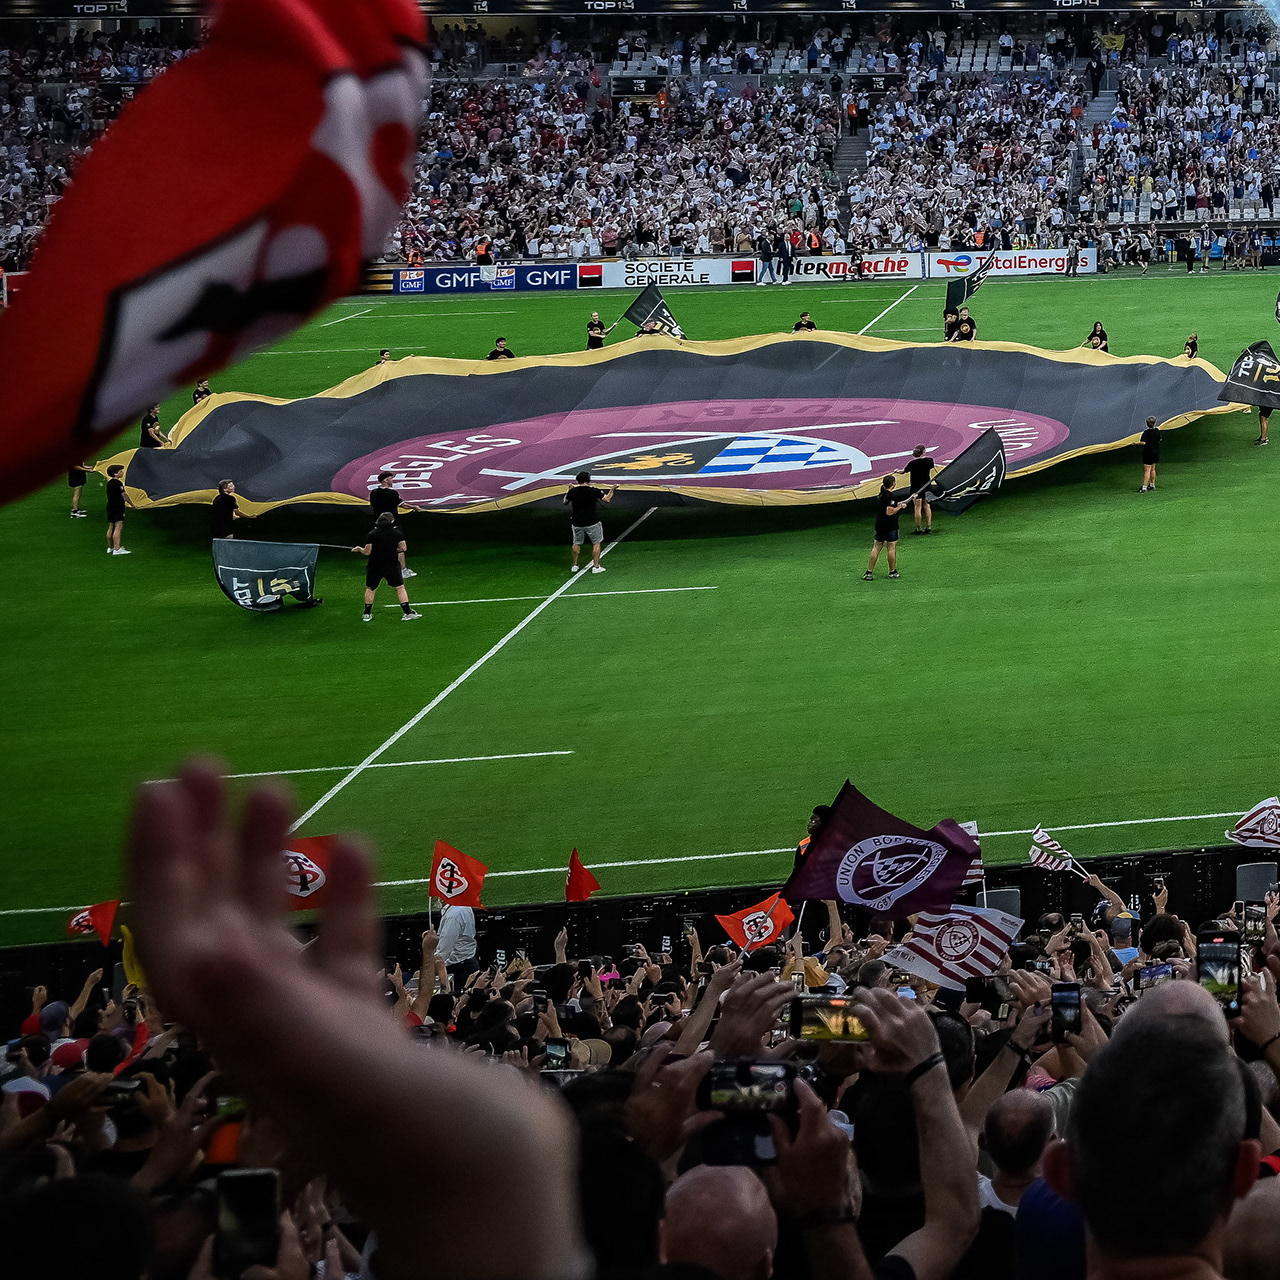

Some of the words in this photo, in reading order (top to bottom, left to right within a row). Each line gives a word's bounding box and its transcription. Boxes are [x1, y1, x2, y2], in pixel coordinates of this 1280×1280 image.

[624, 262, 695, 274] SOCIETE
[975, 255, 1089, 272] TtalEnergs
[402, 280, 423, 289] GMF
[435, 273, 481, 288] GMF
[492, 278, 514, 287] GMF
[526, 270, 572, 285] GMF
[624, 273, 710, 286] GENERALE
[657, 405, 882, 421] RUGBY
[968, 419, 1040, 457] UNIO
[839, 845, 865, 886] UNION
